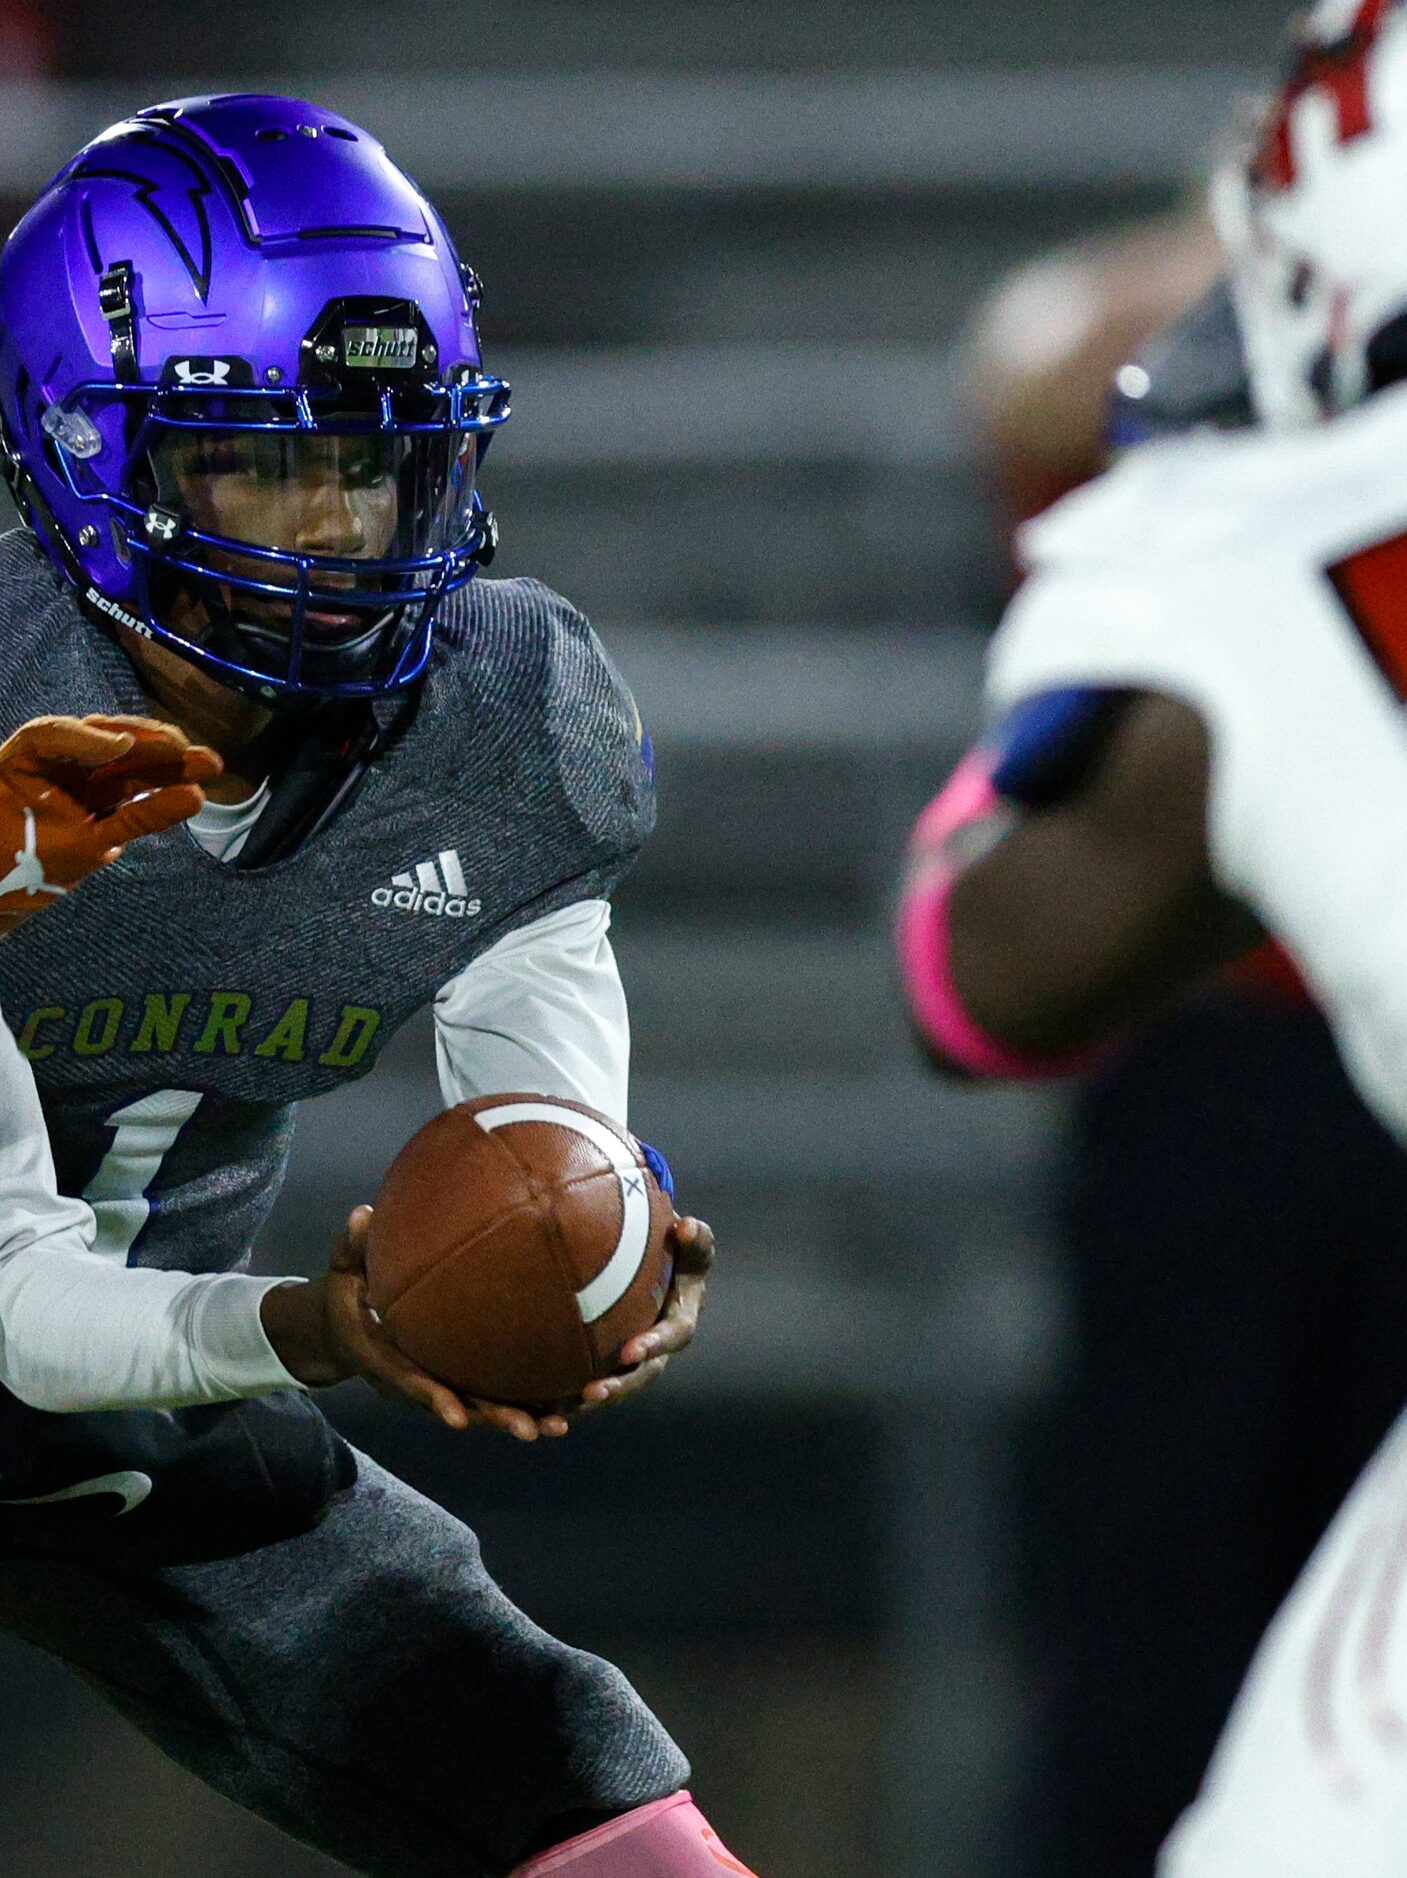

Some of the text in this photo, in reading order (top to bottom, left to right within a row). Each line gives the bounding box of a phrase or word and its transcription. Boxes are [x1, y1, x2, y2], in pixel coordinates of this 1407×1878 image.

[346, 335, 415, 357] schutt
[85, 586, 153, 640] schutt
[371, 886, 481, 918] adidas
[20, 992, 381, 1067] CONRAD
